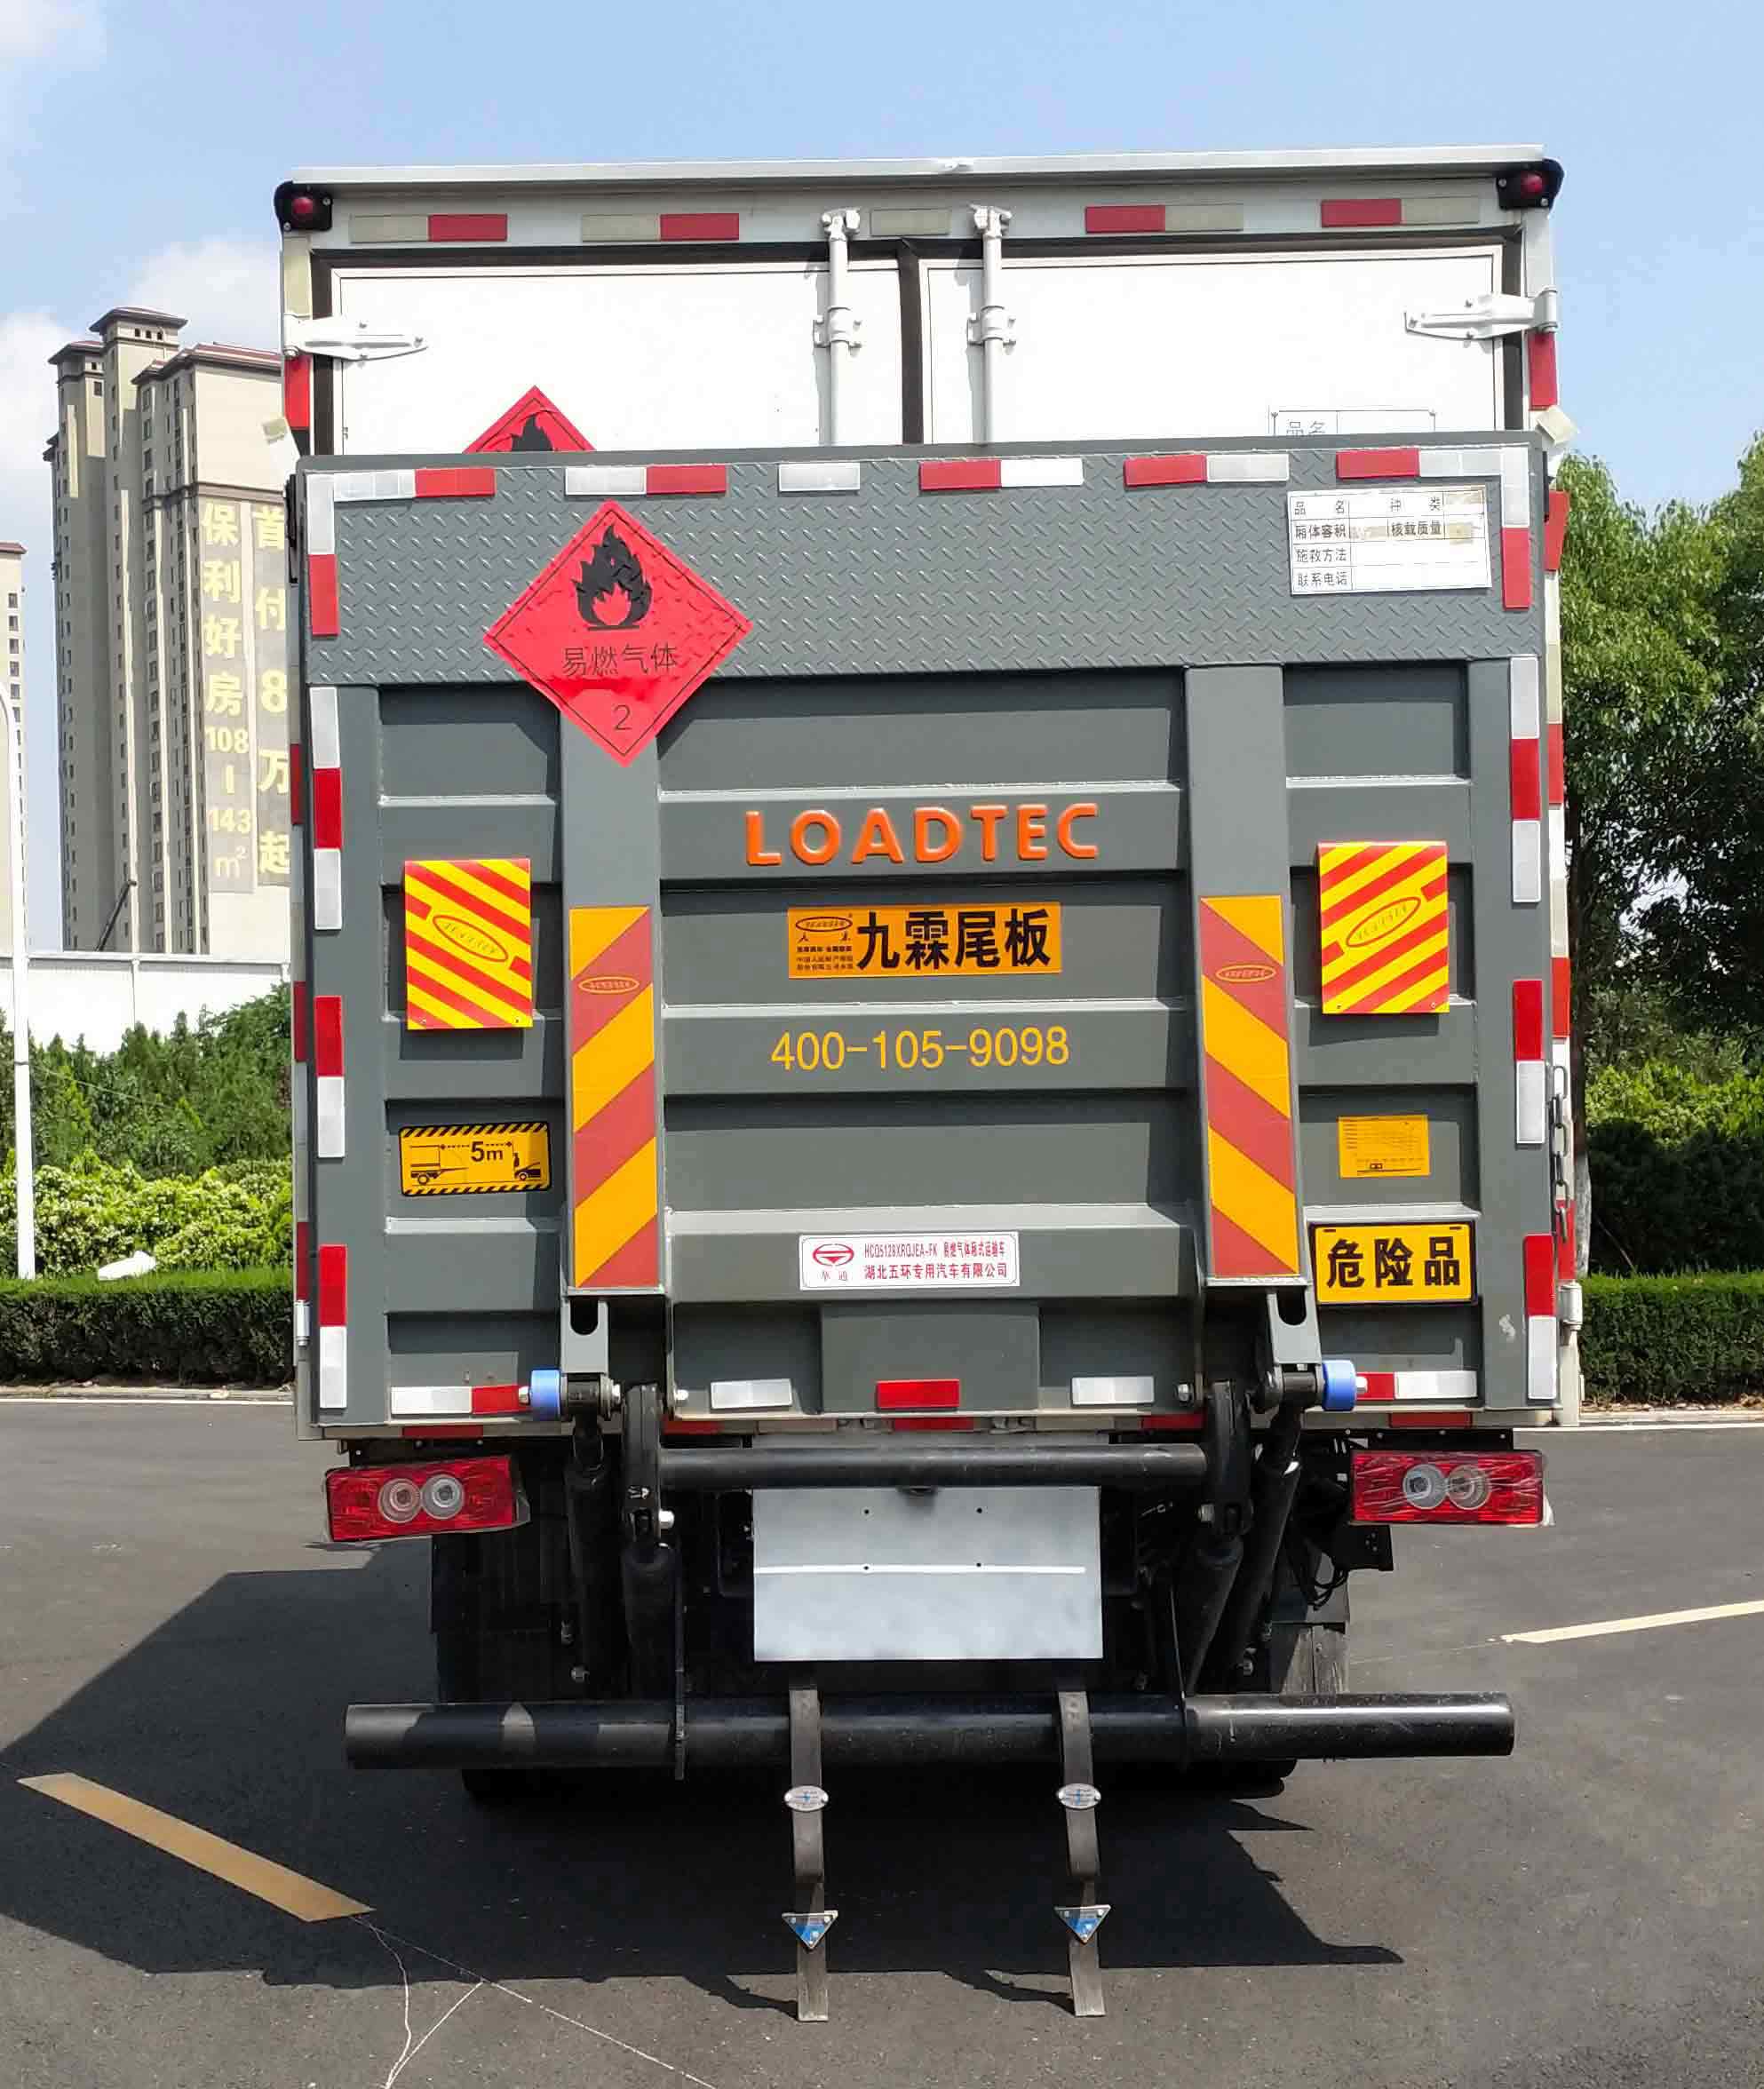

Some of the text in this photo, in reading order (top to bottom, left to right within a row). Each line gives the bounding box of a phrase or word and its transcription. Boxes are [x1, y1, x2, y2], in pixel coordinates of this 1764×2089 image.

[562, 642, 678, 678] 易燃气体
[613, 703, 632, 731] 2
[744, 802, 1099, 866] LOADTEC
[856, 908, 1052, 971] 九霖尾板
[770, 1025, 1070, 1071] 400-105-9098
[471, 1141, 504, 1162] 5m
[864, 1262, 1007, 1280] 湖北五环专用汽车有限公司
[1326, 1235, 1460, 1289] 危险品
